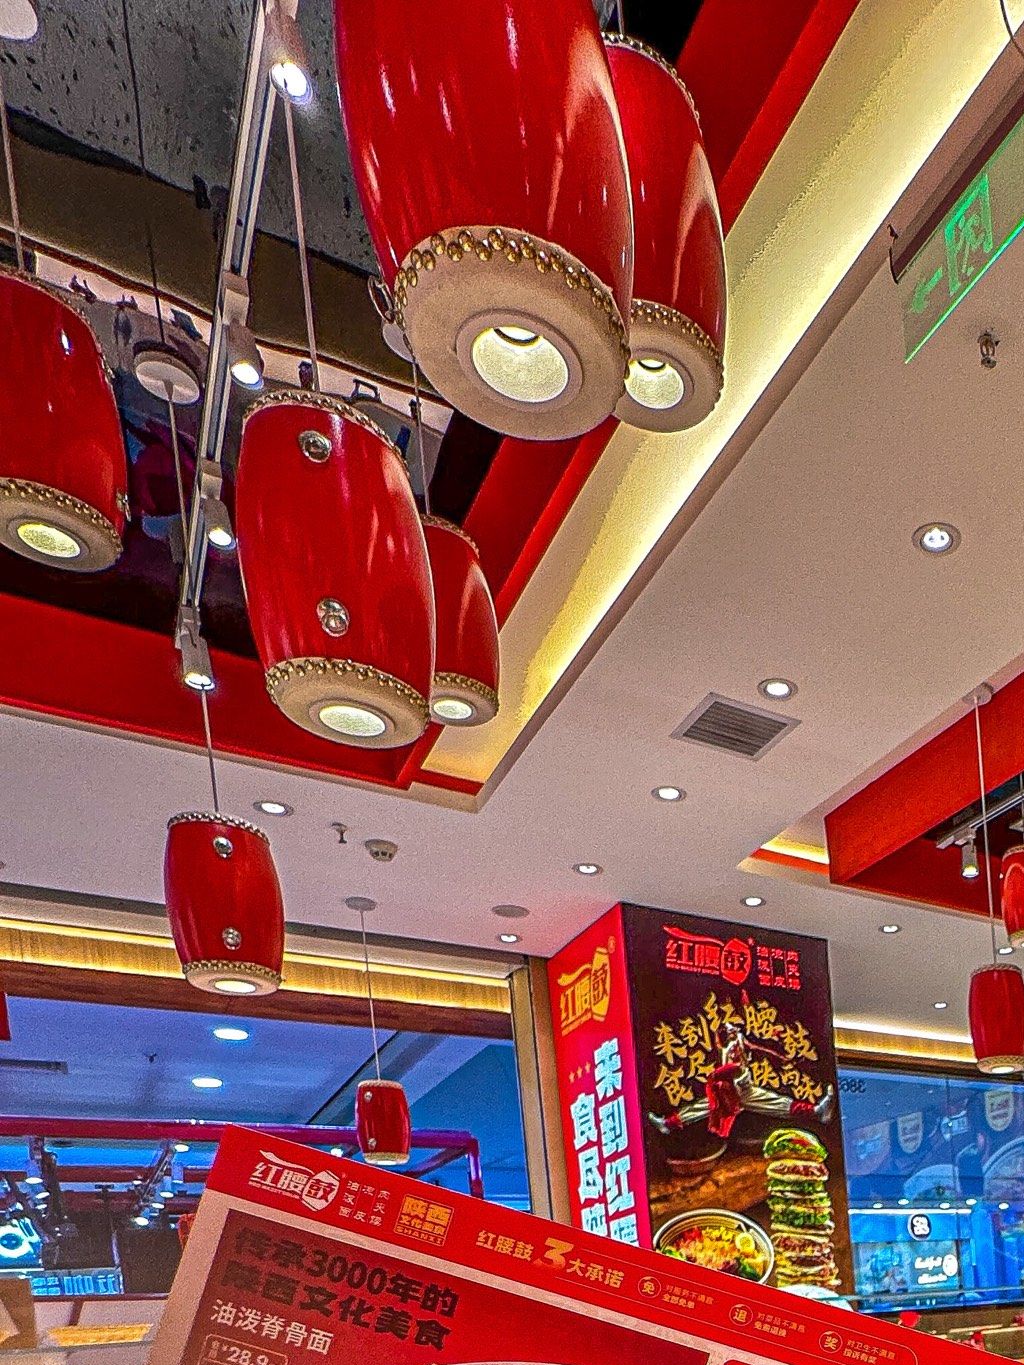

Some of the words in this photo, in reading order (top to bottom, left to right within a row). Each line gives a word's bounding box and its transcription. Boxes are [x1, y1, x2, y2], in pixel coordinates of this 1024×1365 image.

[666, 938, 752, 985] 红腰鼓
[654, 992, 817, 1064] 来到红腰鼓
[250, 1162, 340, 1211] 红腰鼓
[475, 1228, 624, 1289] 红腰鼓3大承诺
[208, 1295, 334, 1358] 油泼脊骨面
[732, 1307, 748, 1323] 退
[822, 1335, 839, 1350] 奖
